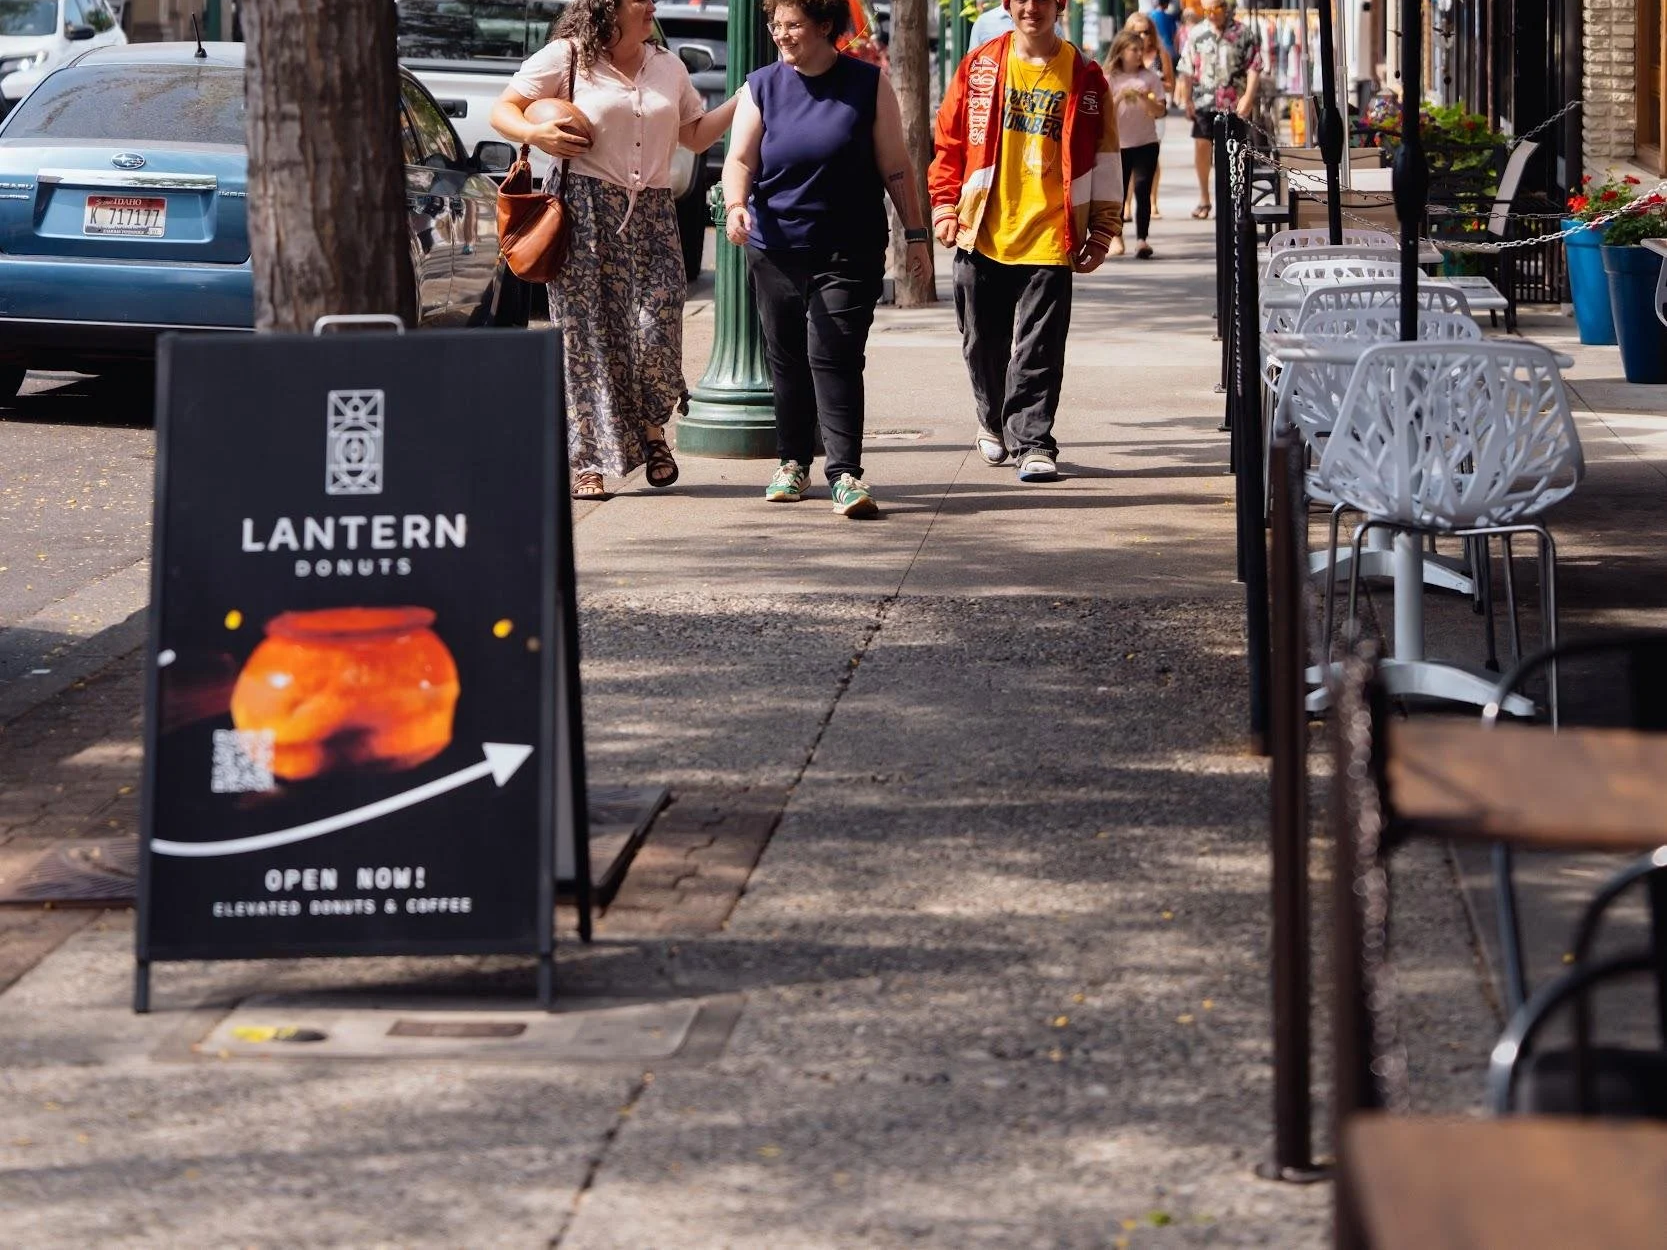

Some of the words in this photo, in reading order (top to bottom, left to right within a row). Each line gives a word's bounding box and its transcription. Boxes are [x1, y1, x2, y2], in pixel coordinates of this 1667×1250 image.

[969, 55, 998, 145] 49ERS
[113, 198, 142, 207] IDAHO
[90, 207, 98, 224] K
[108, 208, 160, 228] 717177
[241, 513, 467, 552] LANTERN
[295, 558, 412, 577] DONUTS
[264, 868, 338, 892] OPEN
[356, 866, 426, 890] NOW!
[213, 900, 301, 917] ELEVATED
[309, 899, 376, 916] DONUTS
[406, 897, 472, 915] COFFEE
